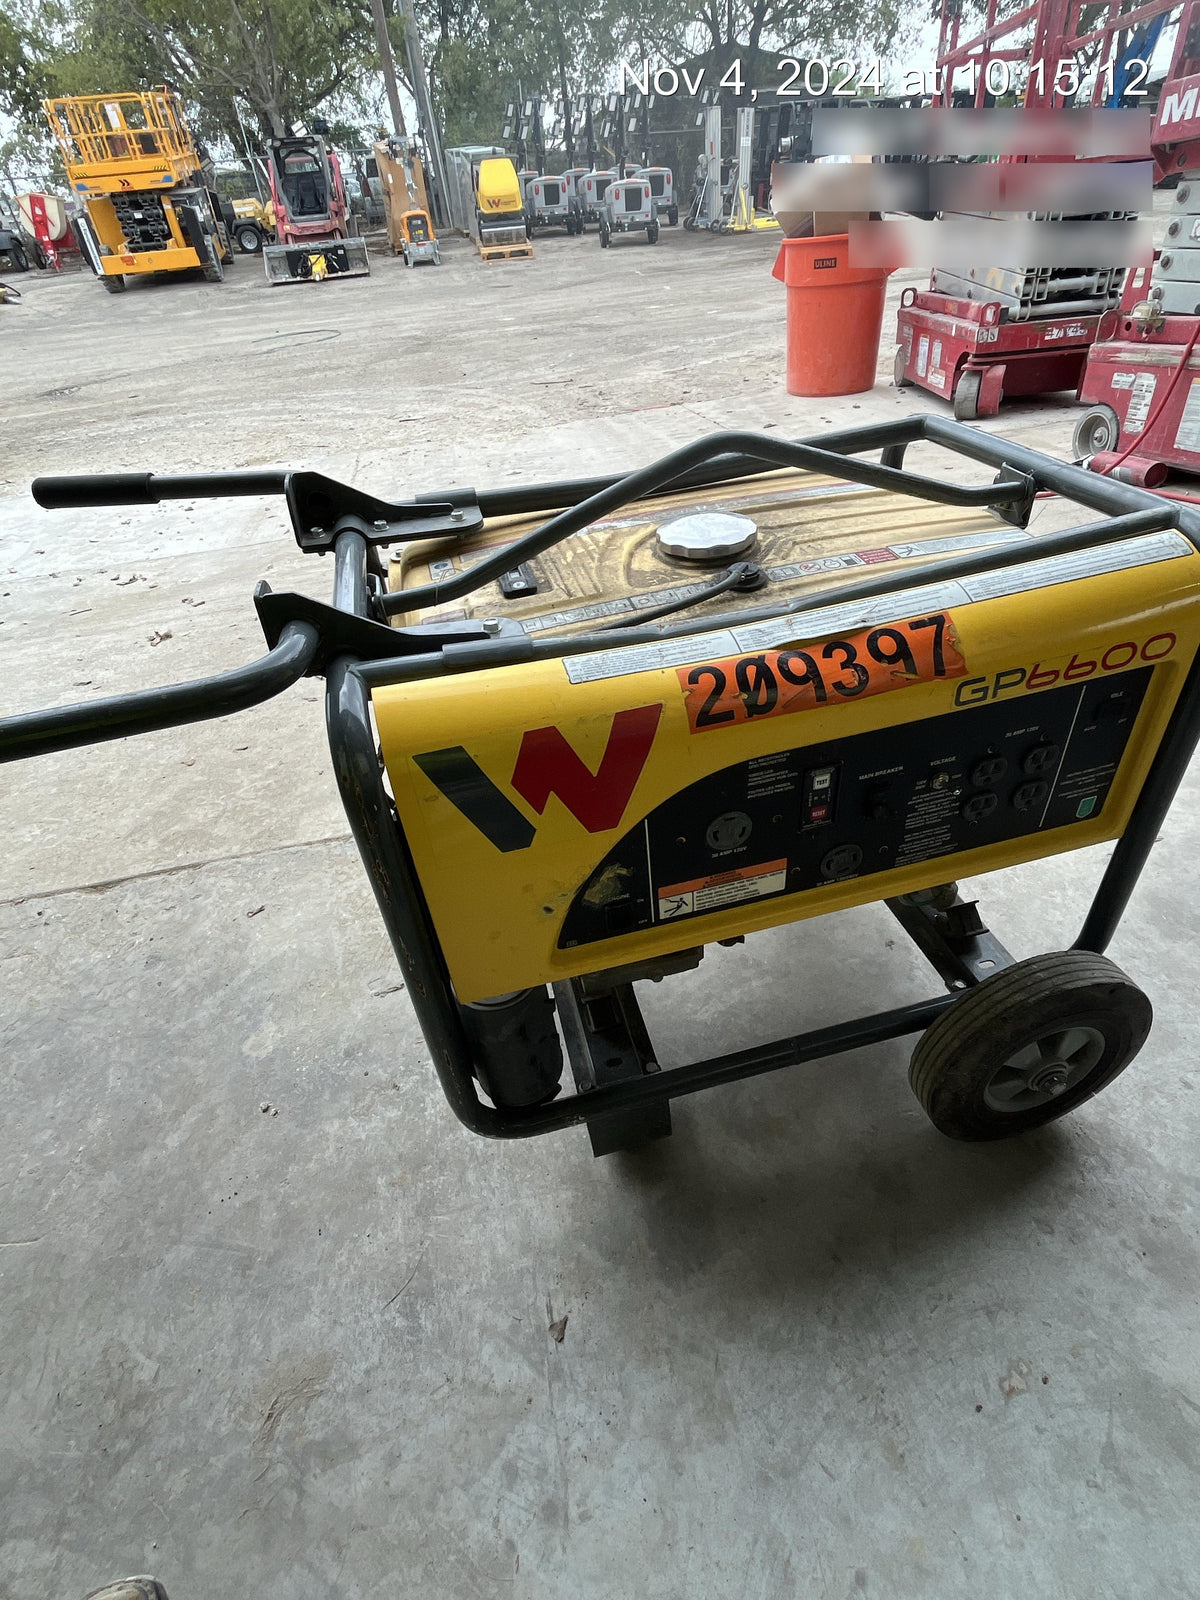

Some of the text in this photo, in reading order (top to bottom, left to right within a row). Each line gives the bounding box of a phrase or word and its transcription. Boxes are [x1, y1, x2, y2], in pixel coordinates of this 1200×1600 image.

[814, 258, 837, 268] ULINE
[954, 632, 1177, 708] GP6600
[930, 755, 957, 767] VOLTAGE
[858, 765, 904, 781] MAIN BREAKER
[816, 778, 828, 786] TEST
[811, 809, 826, 818] RESET
